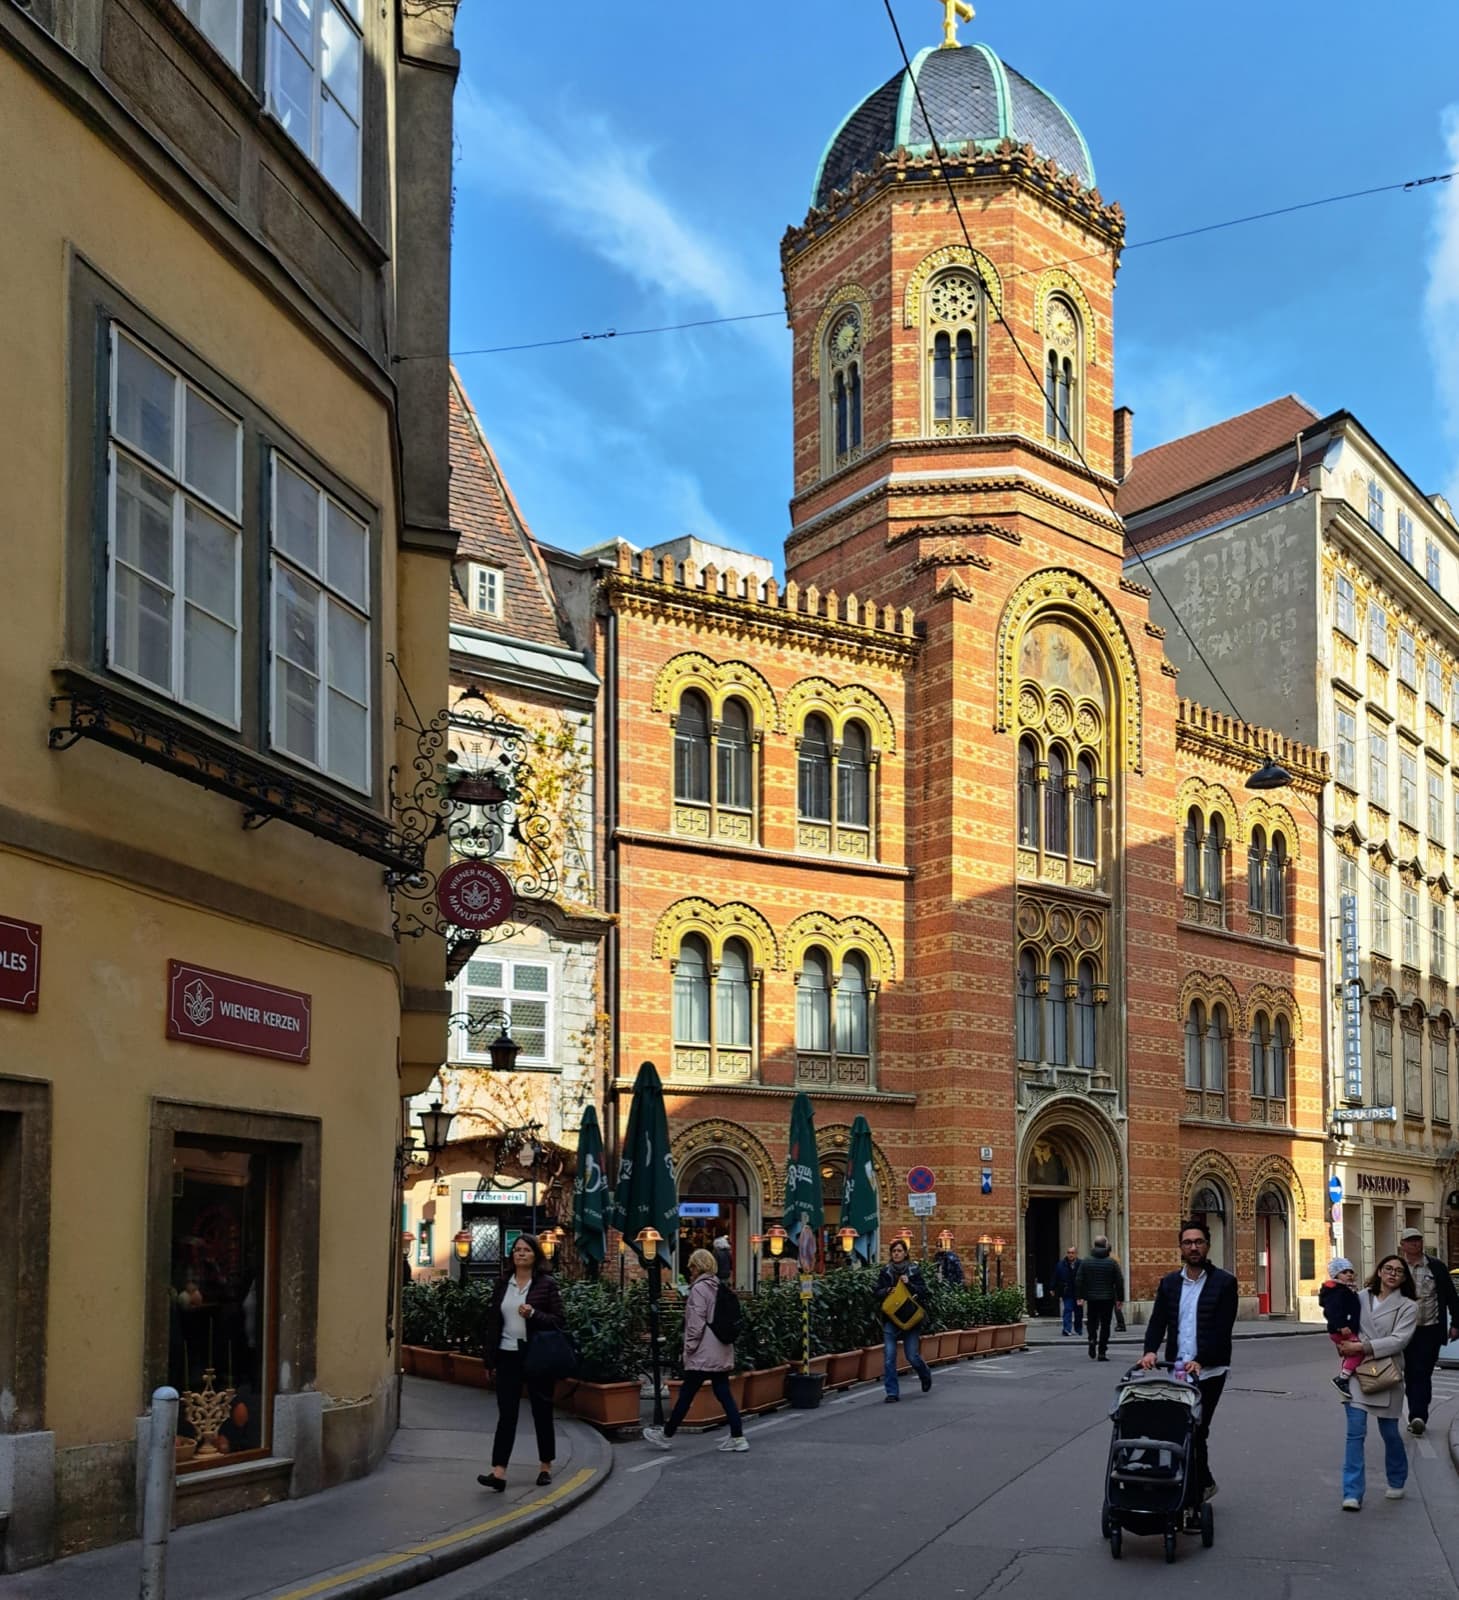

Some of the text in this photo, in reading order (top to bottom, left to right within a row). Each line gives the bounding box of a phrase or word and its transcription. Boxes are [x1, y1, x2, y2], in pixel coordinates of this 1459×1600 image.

[449, 869, 502, 893] WIENER KERZEN
[448, 895, 503, 921] MANUFAKTUR
[219, 1001, 300, 1032] WIENER KERZEN
[1336, 1108, 1391, 1120] ISSAKIDES
[1357, 1174, 1410, 1193] ISSAKIDES
